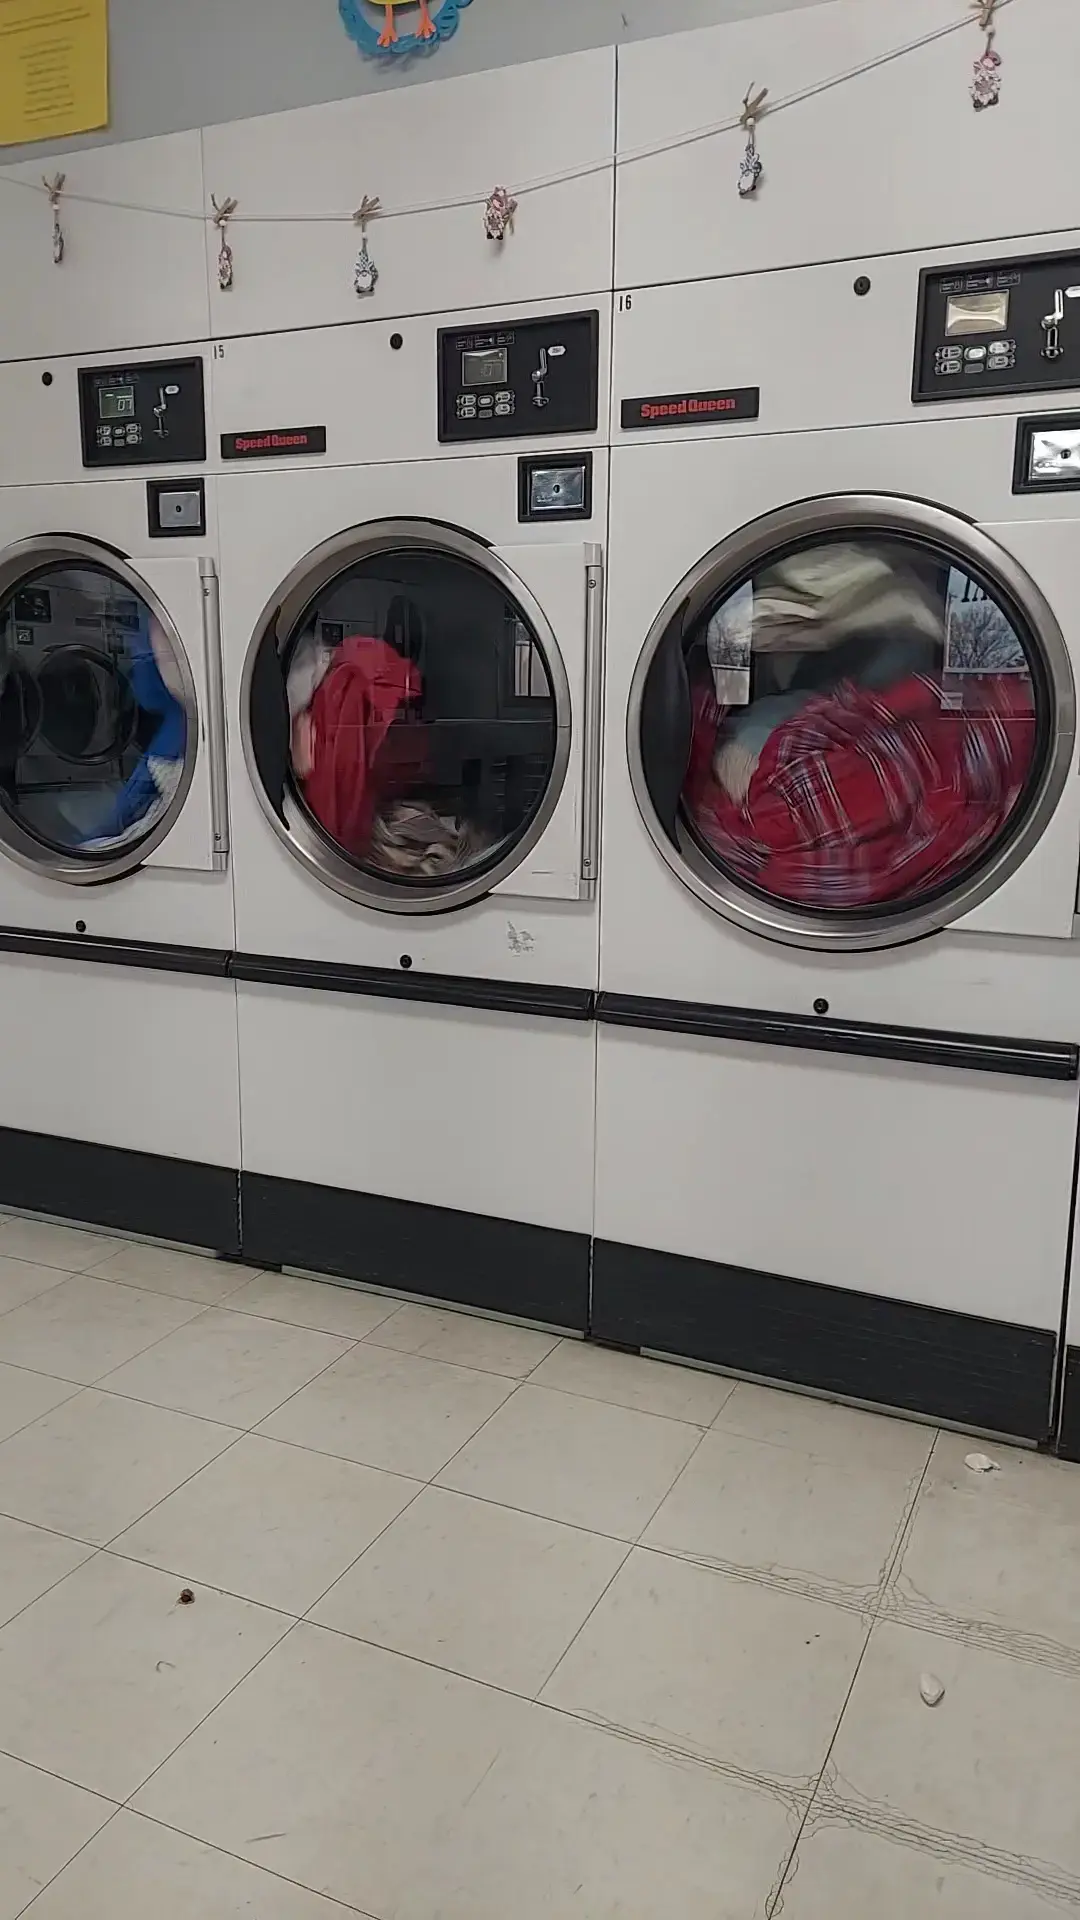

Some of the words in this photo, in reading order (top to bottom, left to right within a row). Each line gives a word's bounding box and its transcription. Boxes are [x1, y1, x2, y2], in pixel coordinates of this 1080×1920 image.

[619, 294, 632, 312] 16
[213, 344, 225, 360] 15
[640, 400, 687, 419] Speed
[688, 398, 736, 413] Queen
[235, 435, 271, 451] Speed
[271, 434, 308, 446] Queen
